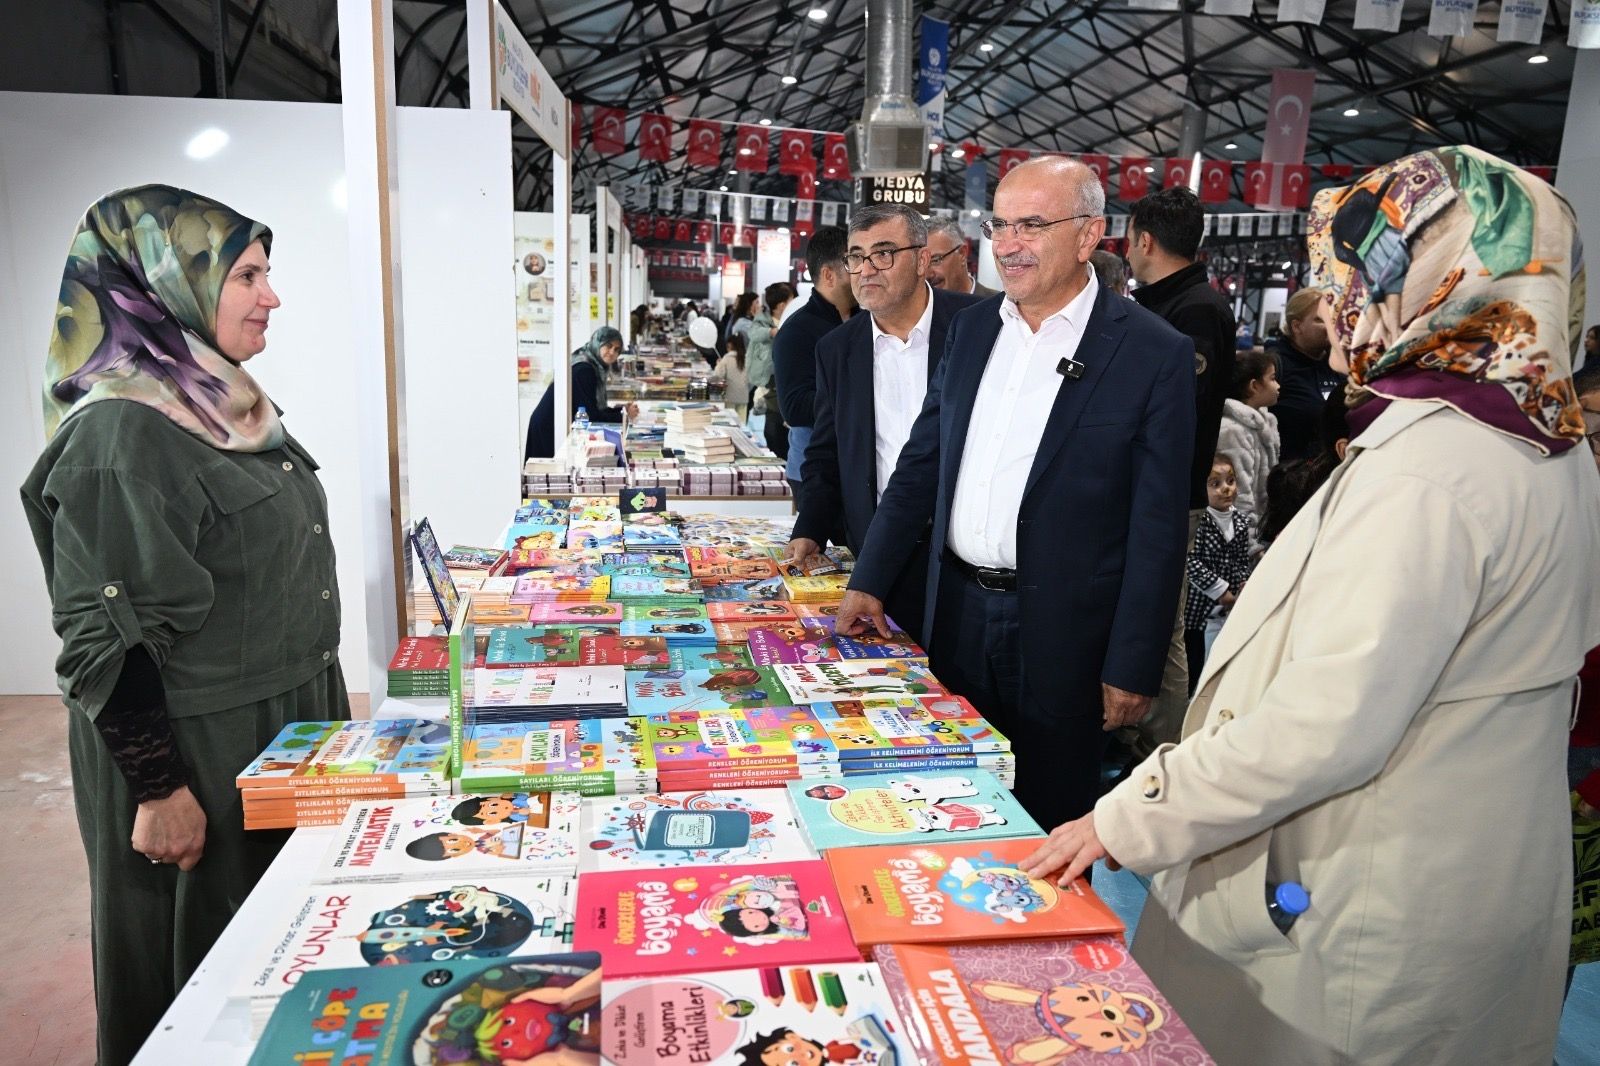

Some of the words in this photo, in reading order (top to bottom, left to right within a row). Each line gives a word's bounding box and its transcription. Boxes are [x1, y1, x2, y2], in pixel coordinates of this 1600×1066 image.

[874, 176, 925, 189] MEDYA
[873, 190, 925, 203] GRUBU
[450, 689, 459, 719] SAYILARI
[450, 720, 461, 769] ÖĞRENİYORUM
[926, 745, 970, 755] ÖĞRENİYORUM
[740, 757, 788, 767] ÖĞRENİYORUM
[929, 758, 974, 767] ÖĞRENİYORUM
[742, 768, 789, 778] ÖĞRENİYORUM
[288, 778, 327, 787] ZITLIKLARI
[329, 776, 382, 785] ÖĞRENİYORUM
[745, 778, 788, 787] ÖĞRENİYORU
[294, 789, 333, 797] ZITLIKLARI
[335, 786, 389, 796] ÖĞRENİYORUM
[295, 799, 334, 808] ZITLIKLARI
[296, 809, 335, 817] ZITLIKLARI
[296, 818, 335, 826] ZITLIKLARI
[348, 805, 394, 867] MATEMATİK
[887, 858, 945, 926] boyama
[636, 880, 683, 956] boyama
[282, 895, 352, 985] OYUNLAR
[311, 985, 359, 1046] ÇÖPE
[655, 1000, 687, 1059] Boyama
[682, 985, 713, 1064] Etkinlikleri
